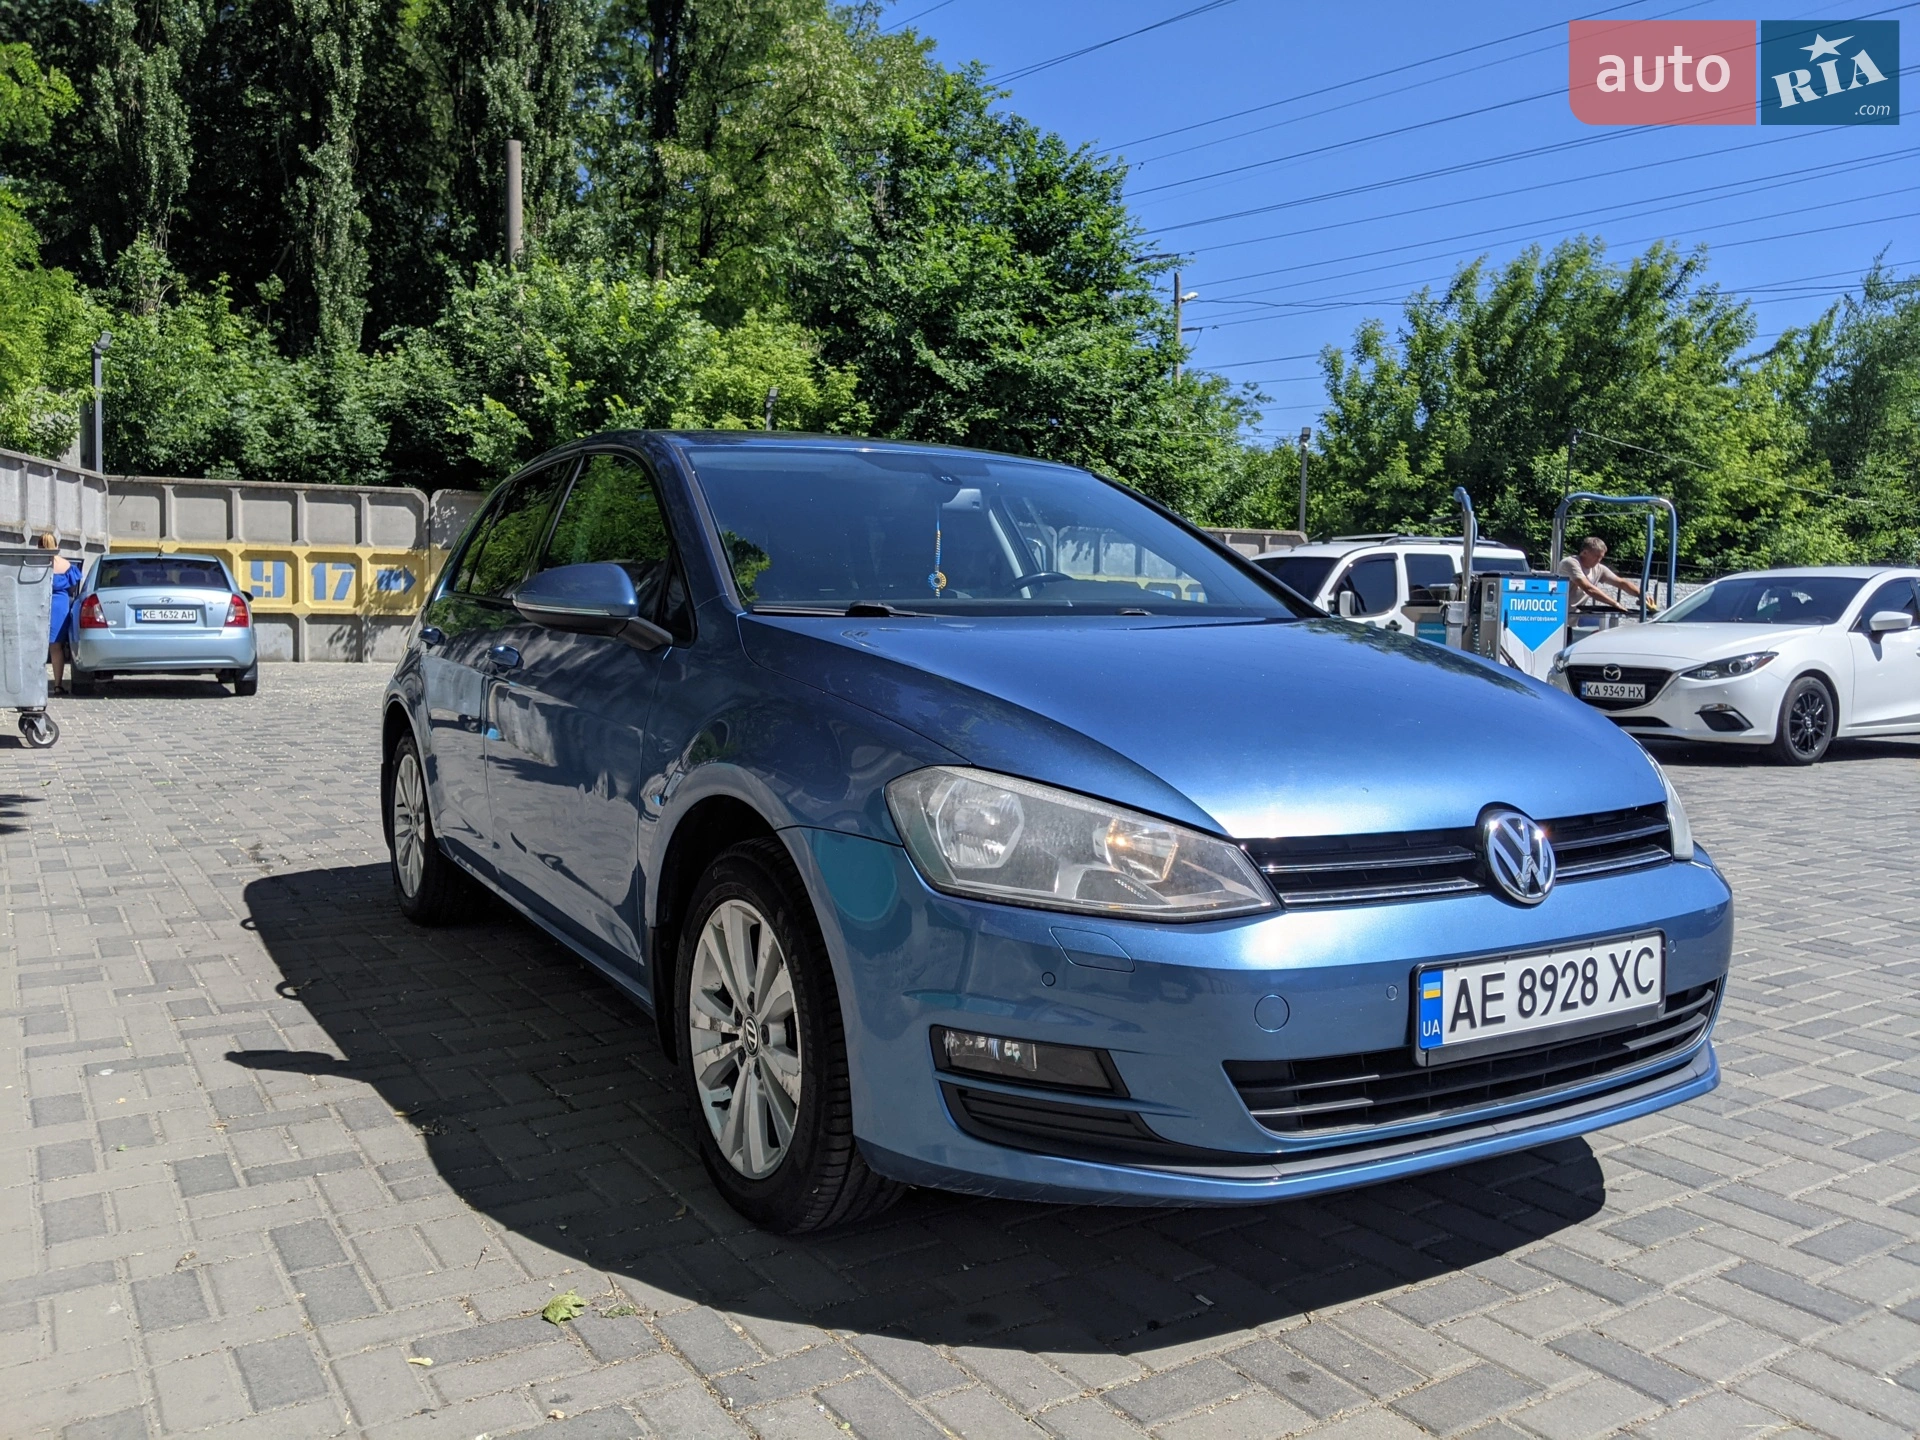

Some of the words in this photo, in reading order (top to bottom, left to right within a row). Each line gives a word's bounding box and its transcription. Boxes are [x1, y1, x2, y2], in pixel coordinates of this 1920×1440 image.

[311, 562, 356, 601] 17
[1510, 598, 1558, 612] ПИЛОСОС
[142, 610, 157, 619] KE
[159, 610, 179, 619] 1632
[181, 610, 195, 620] AH
[1586, 684, 1600, 696] KA
[1603, 685, 1626, 697] 9349
[1628, 686, 1644, 698] HX
[1448, 971, 1506, 1034] AE
[1517, 956, 1599, 1019] 8928
[1607, 945, 1655, 1003] XC
[1422, 1018, 1441, 1037] UA
